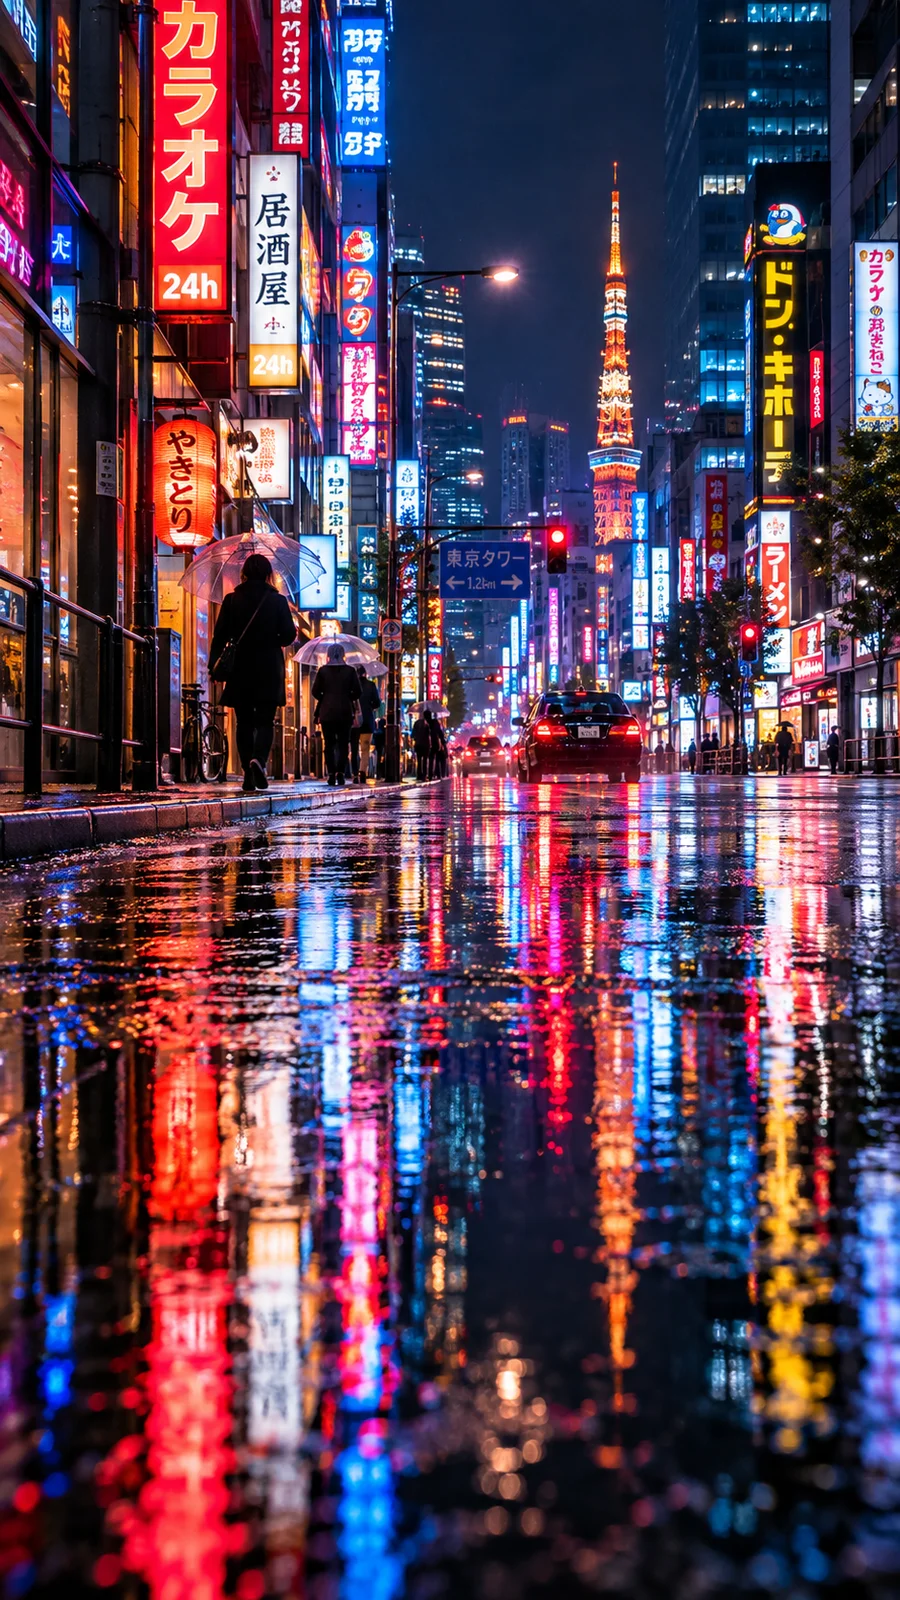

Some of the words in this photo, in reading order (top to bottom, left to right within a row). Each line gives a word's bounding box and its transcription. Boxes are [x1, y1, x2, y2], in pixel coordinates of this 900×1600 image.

[160, 0, 219, 252] カラオケ
[254, 193, 291, 306] 居酒屋
[162, 272, 219, 300] 24h
[252, 354, 294, 376] 24h
[167, 429, 196, 533] やきとり
[446, 548, 525, 568] 東京タワー
[467, 576, 496, 590] 1.2km
[766, 546, 787, 622] ラーメン
